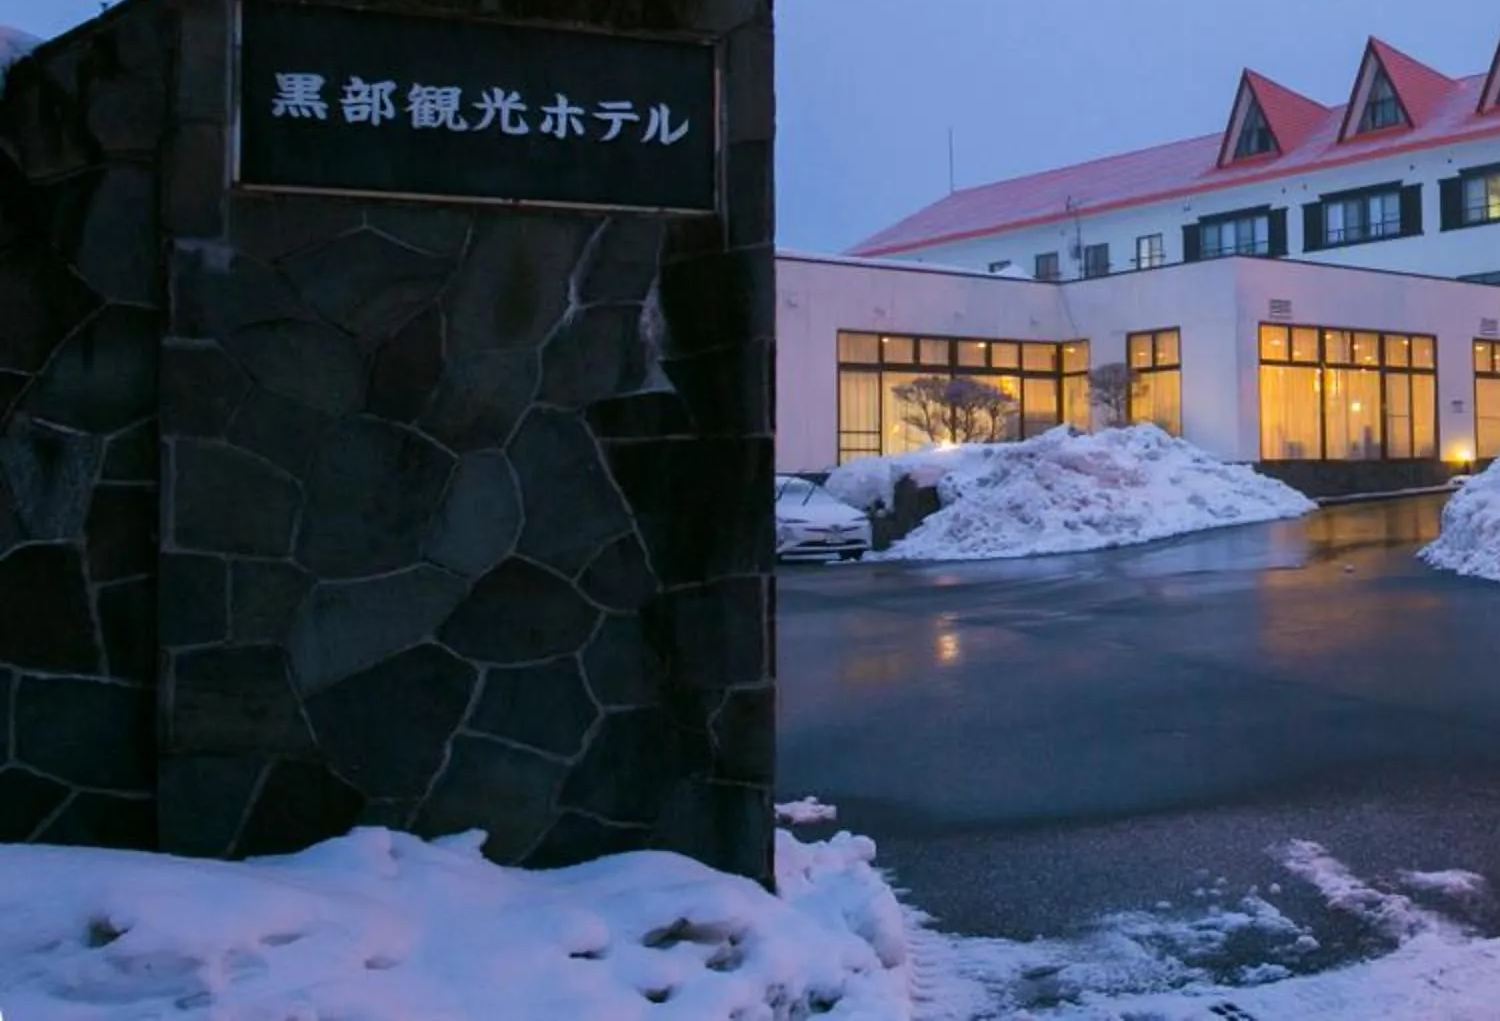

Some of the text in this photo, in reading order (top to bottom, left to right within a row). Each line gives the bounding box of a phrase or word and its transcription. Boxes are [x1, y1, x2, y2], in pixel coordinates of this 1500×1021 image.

[272, 72, 690, 147] 黒部観光ホテル
